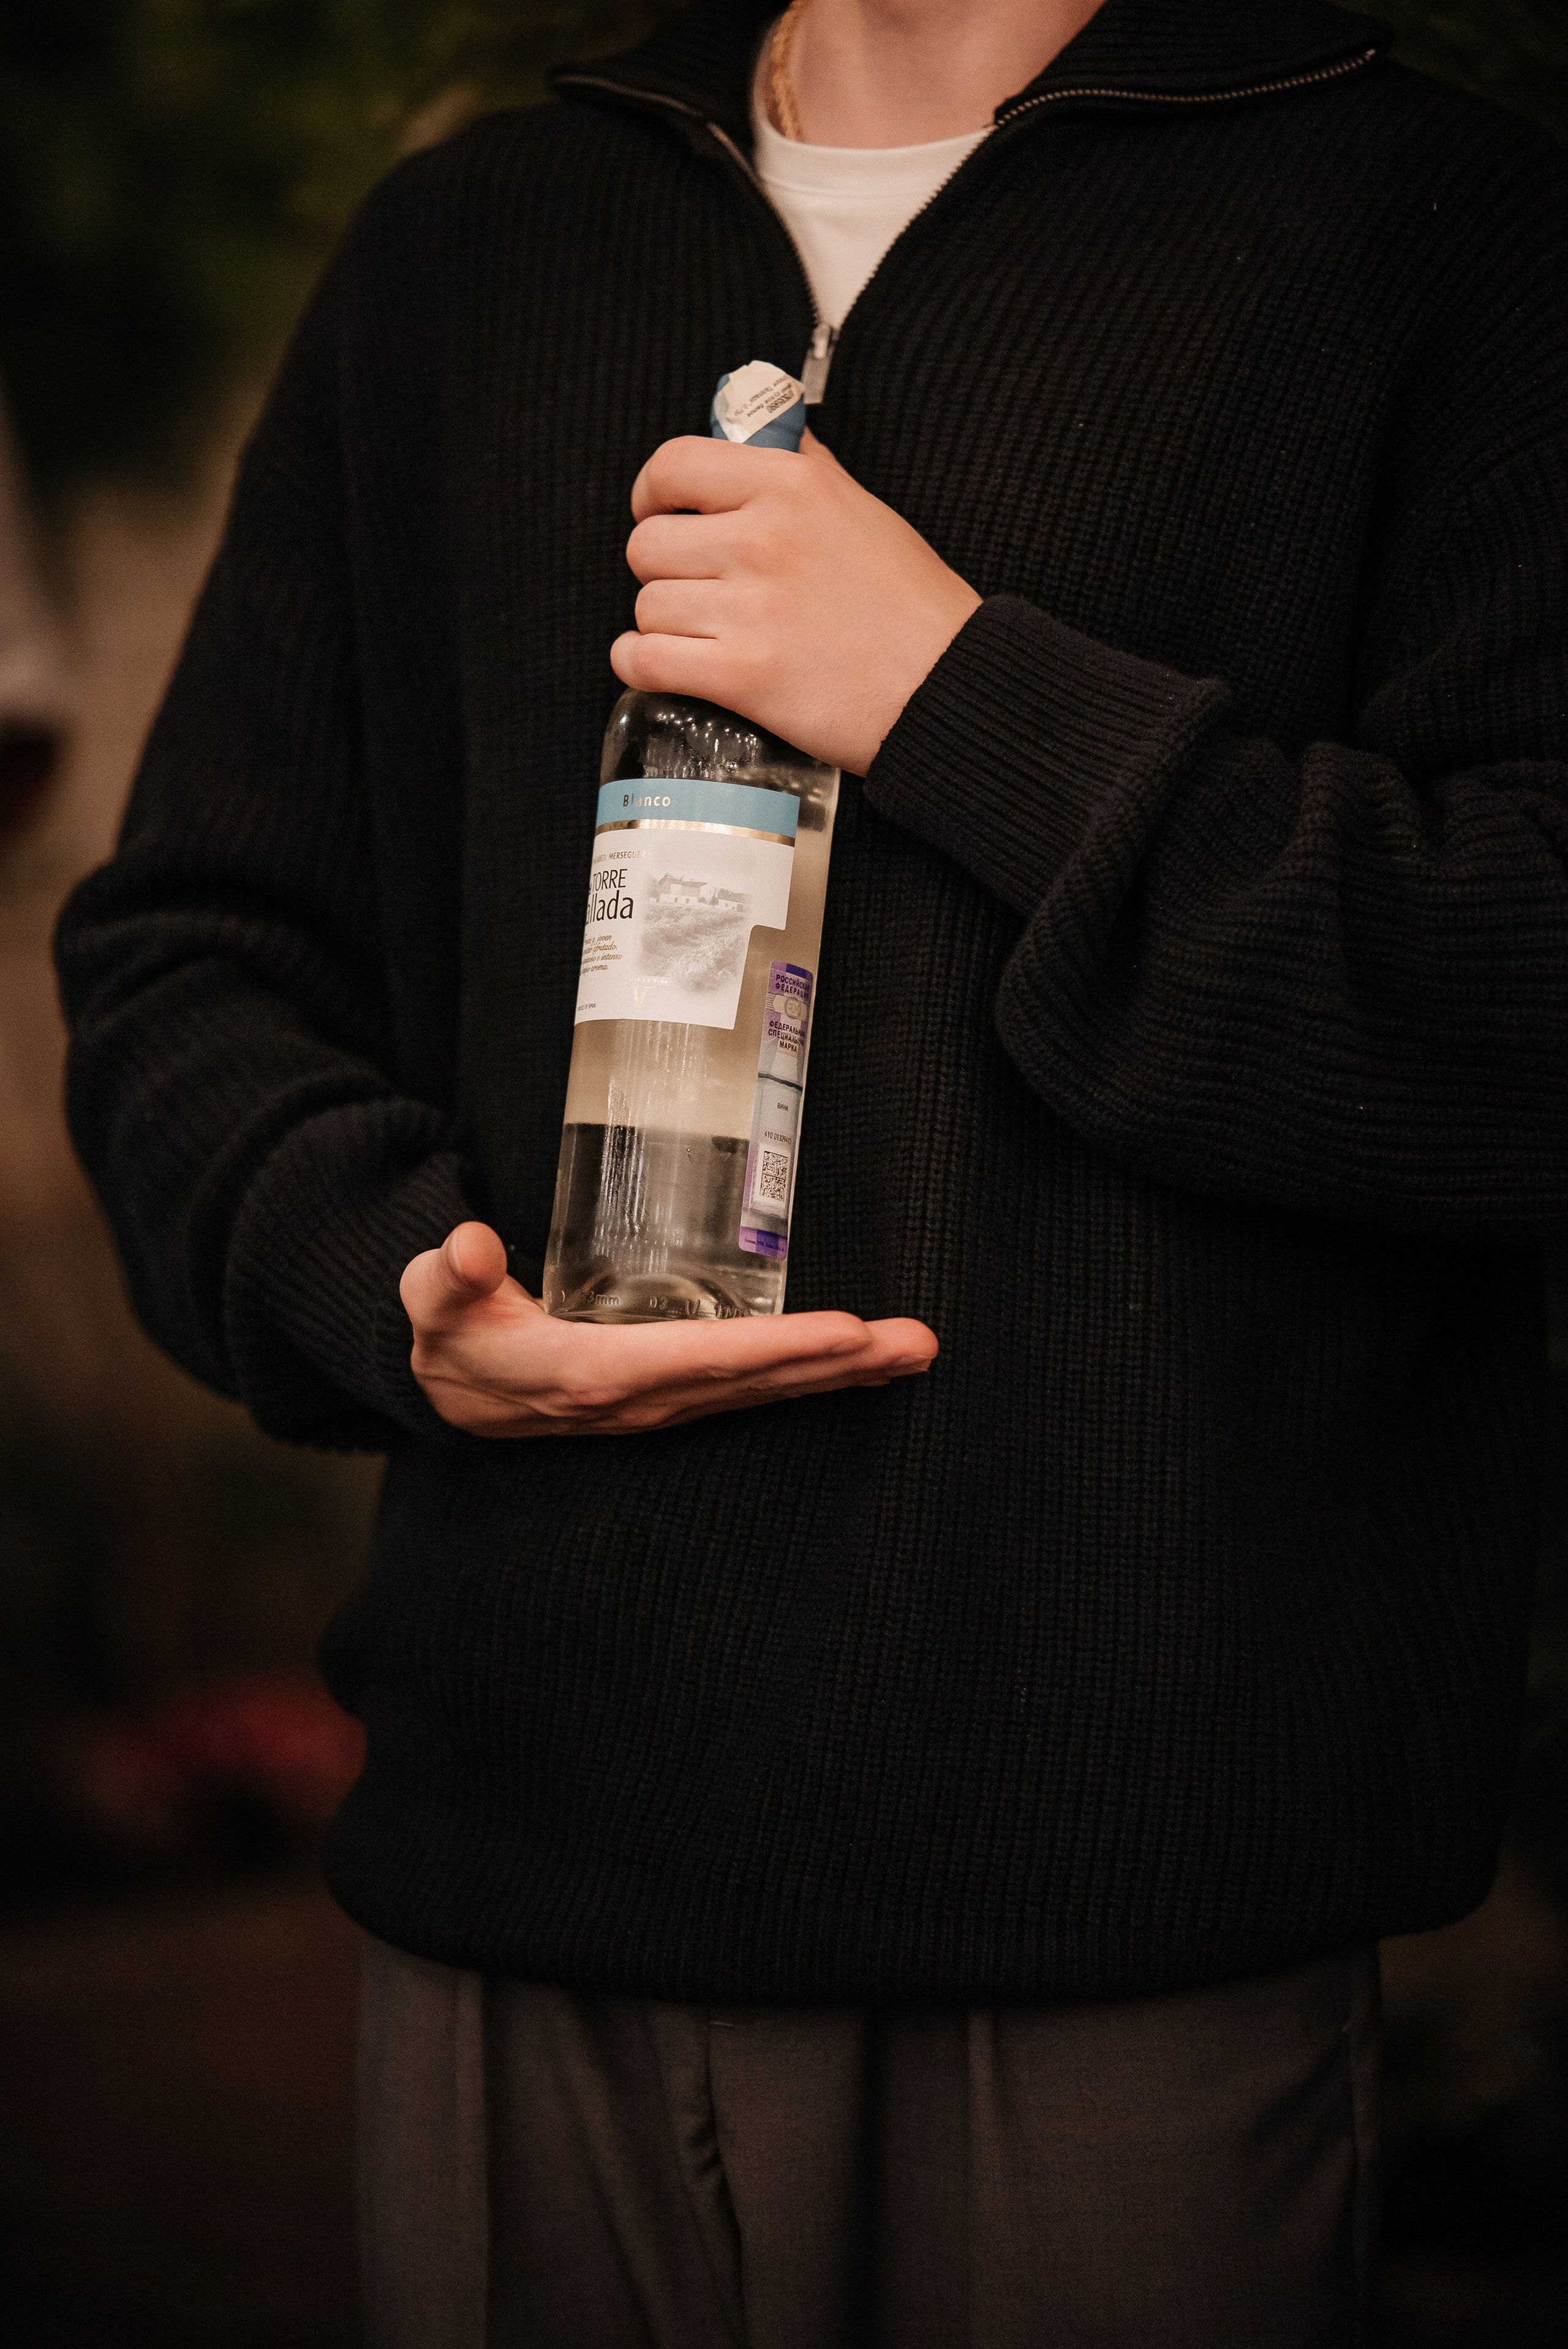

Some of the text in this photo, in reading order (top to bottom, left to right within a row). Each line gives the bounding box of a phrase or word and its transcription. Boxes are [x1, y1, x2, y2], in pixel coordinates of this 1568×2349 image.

[623, 793, 671, 807] Blanco
[592, 869, 627, 892] TORRE
[594, 934, 612, 945] joven
[780, 1041, 797, 1053] МАРКА
[777, 1103, 788, 1111] ВИНА
